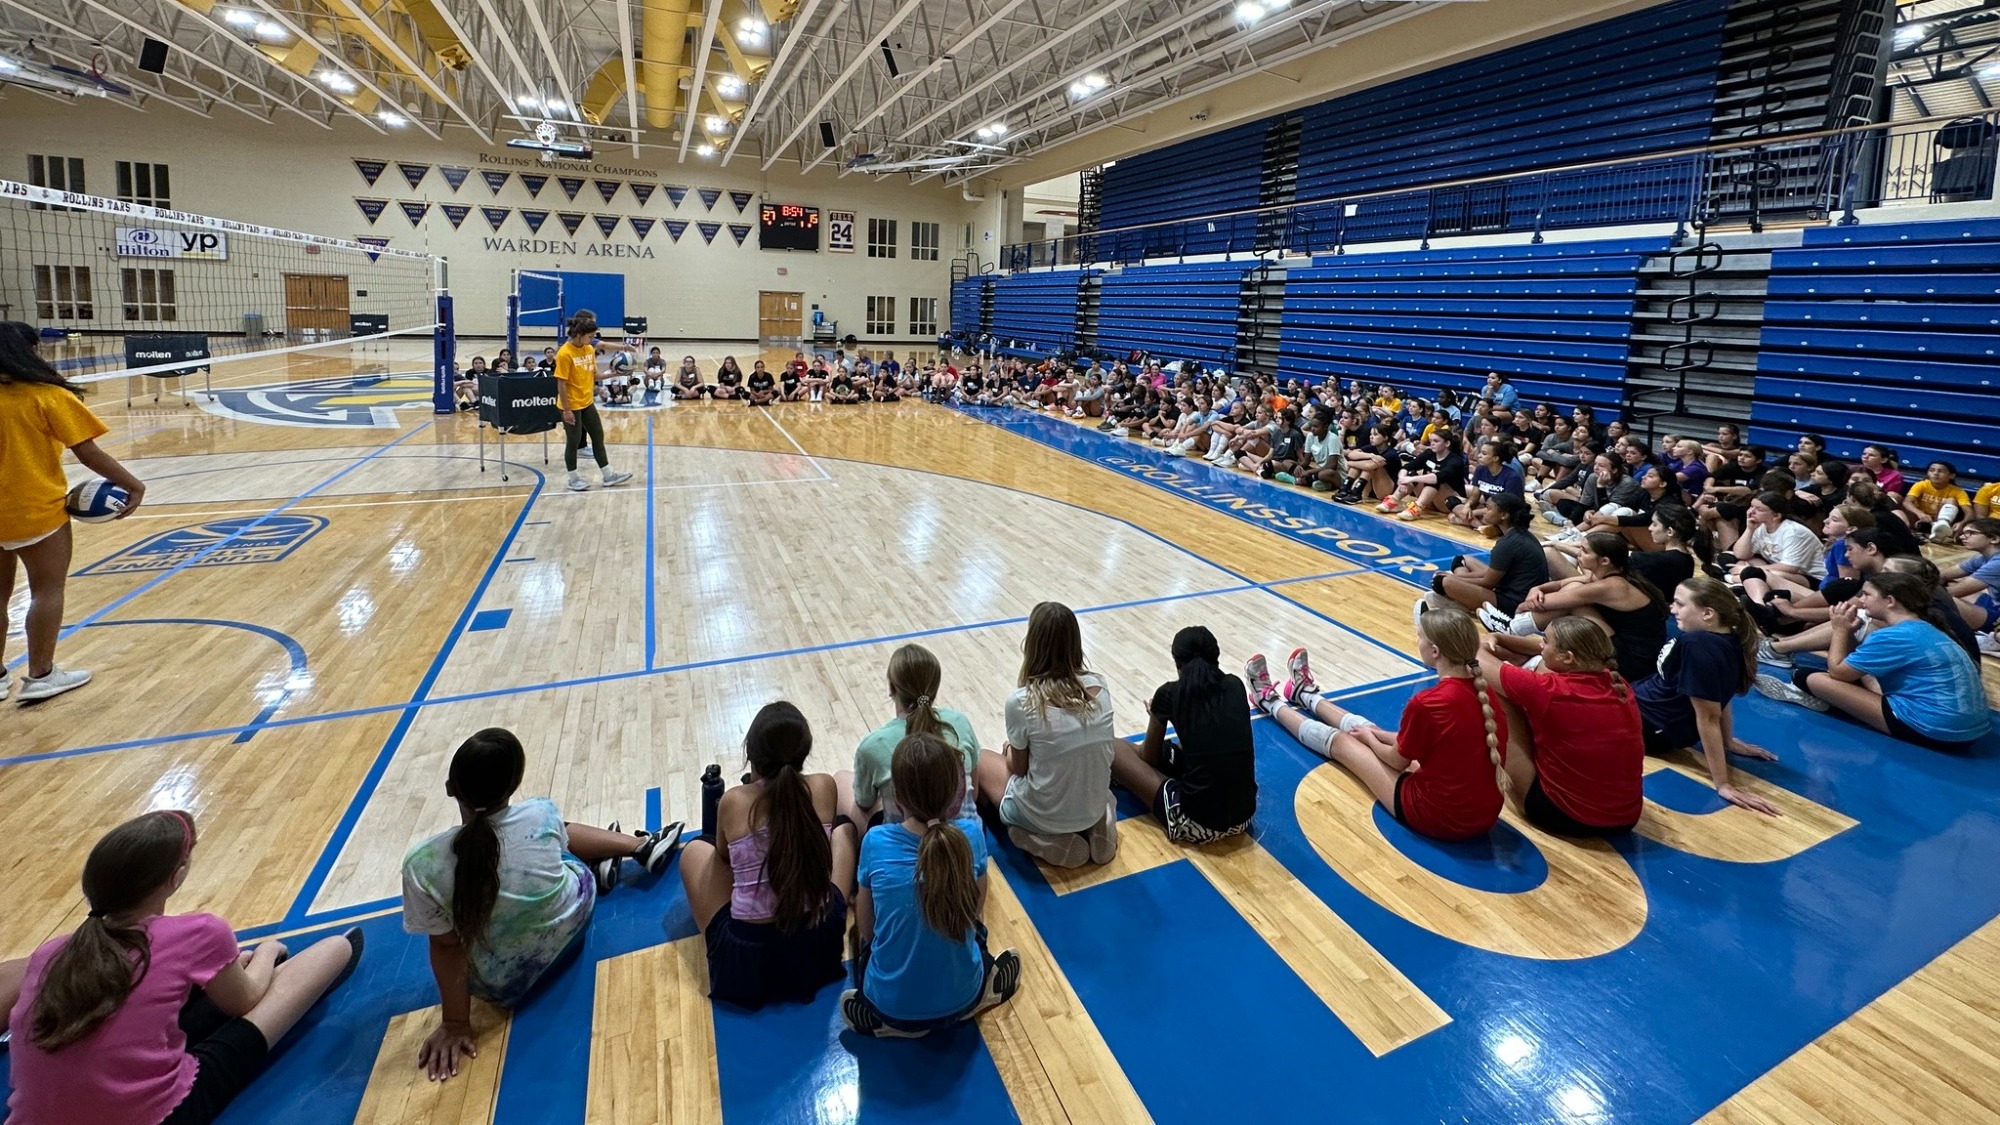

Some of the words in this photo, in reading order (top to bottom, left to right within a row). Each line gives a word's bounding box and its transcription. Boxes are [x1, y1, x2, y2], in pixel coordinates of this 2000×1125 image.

[535, 158, 590, 172] NATIONAL
[594, 164, 658, 178] CHAMPIONS
[1888, 163, 1934, 176] McK
[0, 180, 28, 196] ARS
[62, 192, 104, 209] ROLLINS
[107, 200, 131, 213] TARS
[763, 210, 776, 221] 27
[782, 206, 804, 217] 8:54
[810, 214, 819, 224] 15
[831, 223, 853, 243] 24
[181, 232, 218, 252] yp
[484, 236, 577, 255] WARDEN
[586, 243, 656, 259] ARENA
[118, 244, 170, 257] Hilton
[135, 351, 171, 359] molten
[512, 396, 556, 408] molten
[1098, 455, 1440, 575] @ROLLINSSPOR
